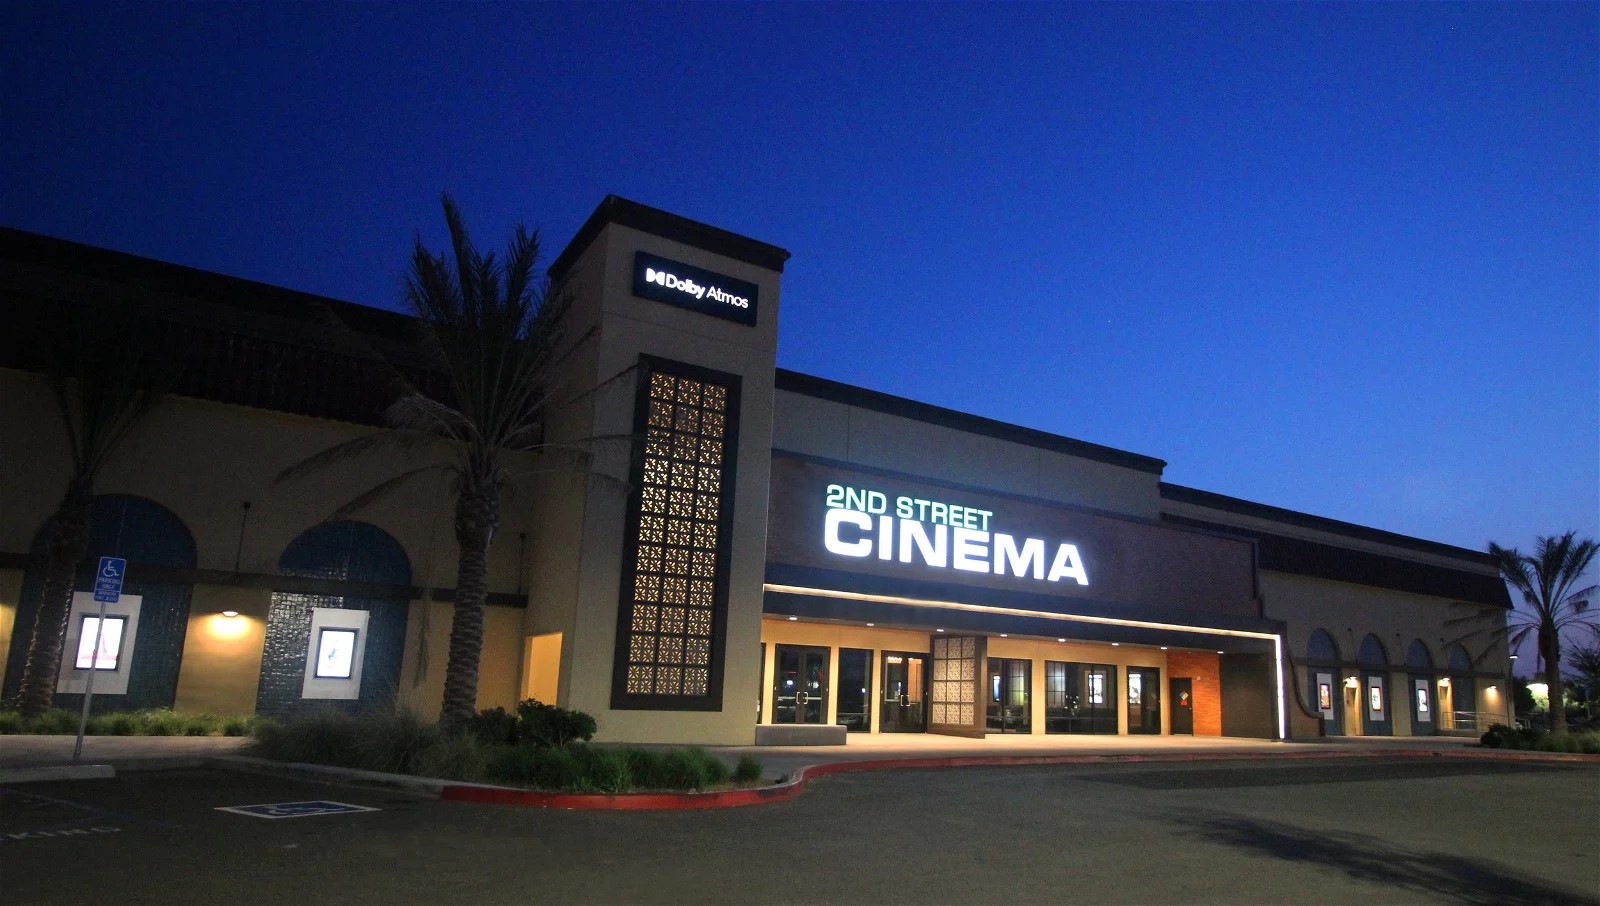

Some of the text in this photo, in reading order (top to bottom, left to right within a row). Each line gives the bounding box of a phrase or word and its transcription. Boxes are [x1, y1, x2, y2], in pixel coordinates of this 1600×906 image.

[666, 274, 749, 309] Dolby Atmos
[826, 484, 993, 531] 2ND STREET
[824, 508, 1090, 586] CINEMA
